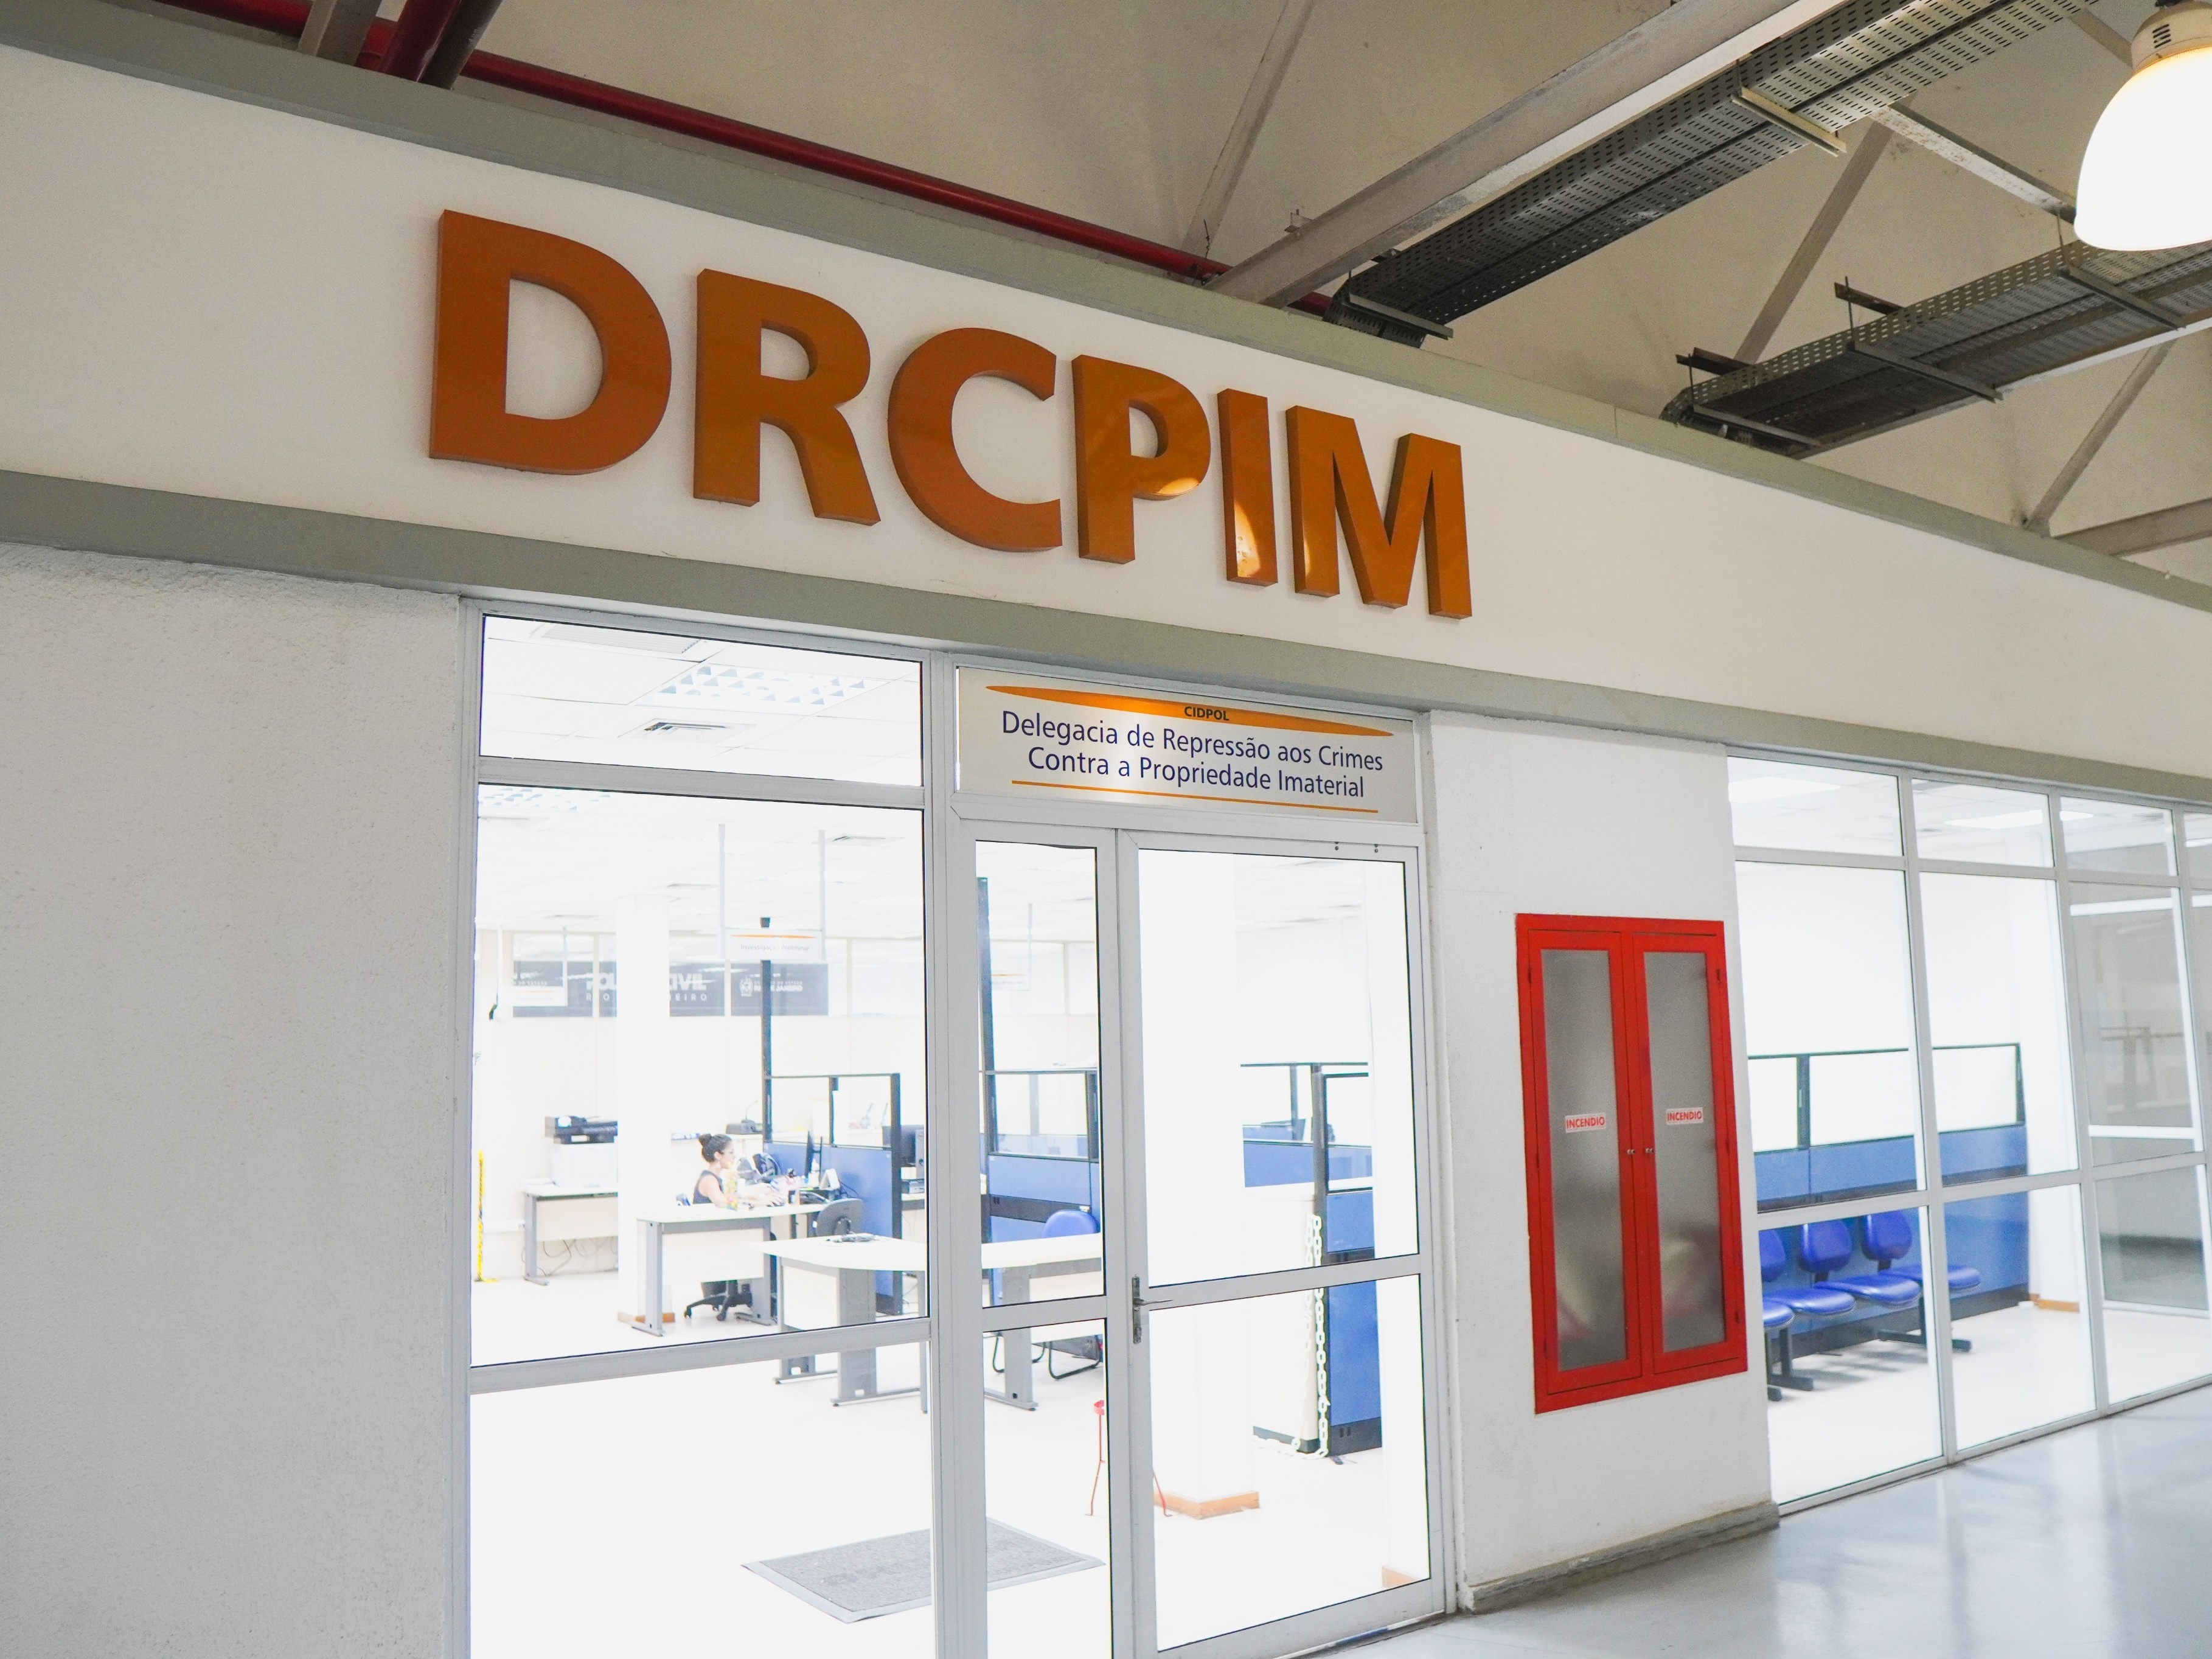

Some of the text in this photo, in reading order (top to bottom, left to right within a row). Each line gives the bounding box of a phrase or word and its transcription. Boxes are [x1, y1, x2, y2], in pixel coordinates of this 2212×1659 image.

[429, 209, 1473, 619] DRCPIM
[1184, 706, 1229, 721] CIDPOL
[1003, 710, 1383, 771] Delegacia de Repressão aos Crimes
[1028, 746, 1364, 798] Contra a Propriedade Imaterial
[1565, 1116, 1605, 1129] INCENDIO
[1666, 1110, 1702, 1122] INCENDIO
